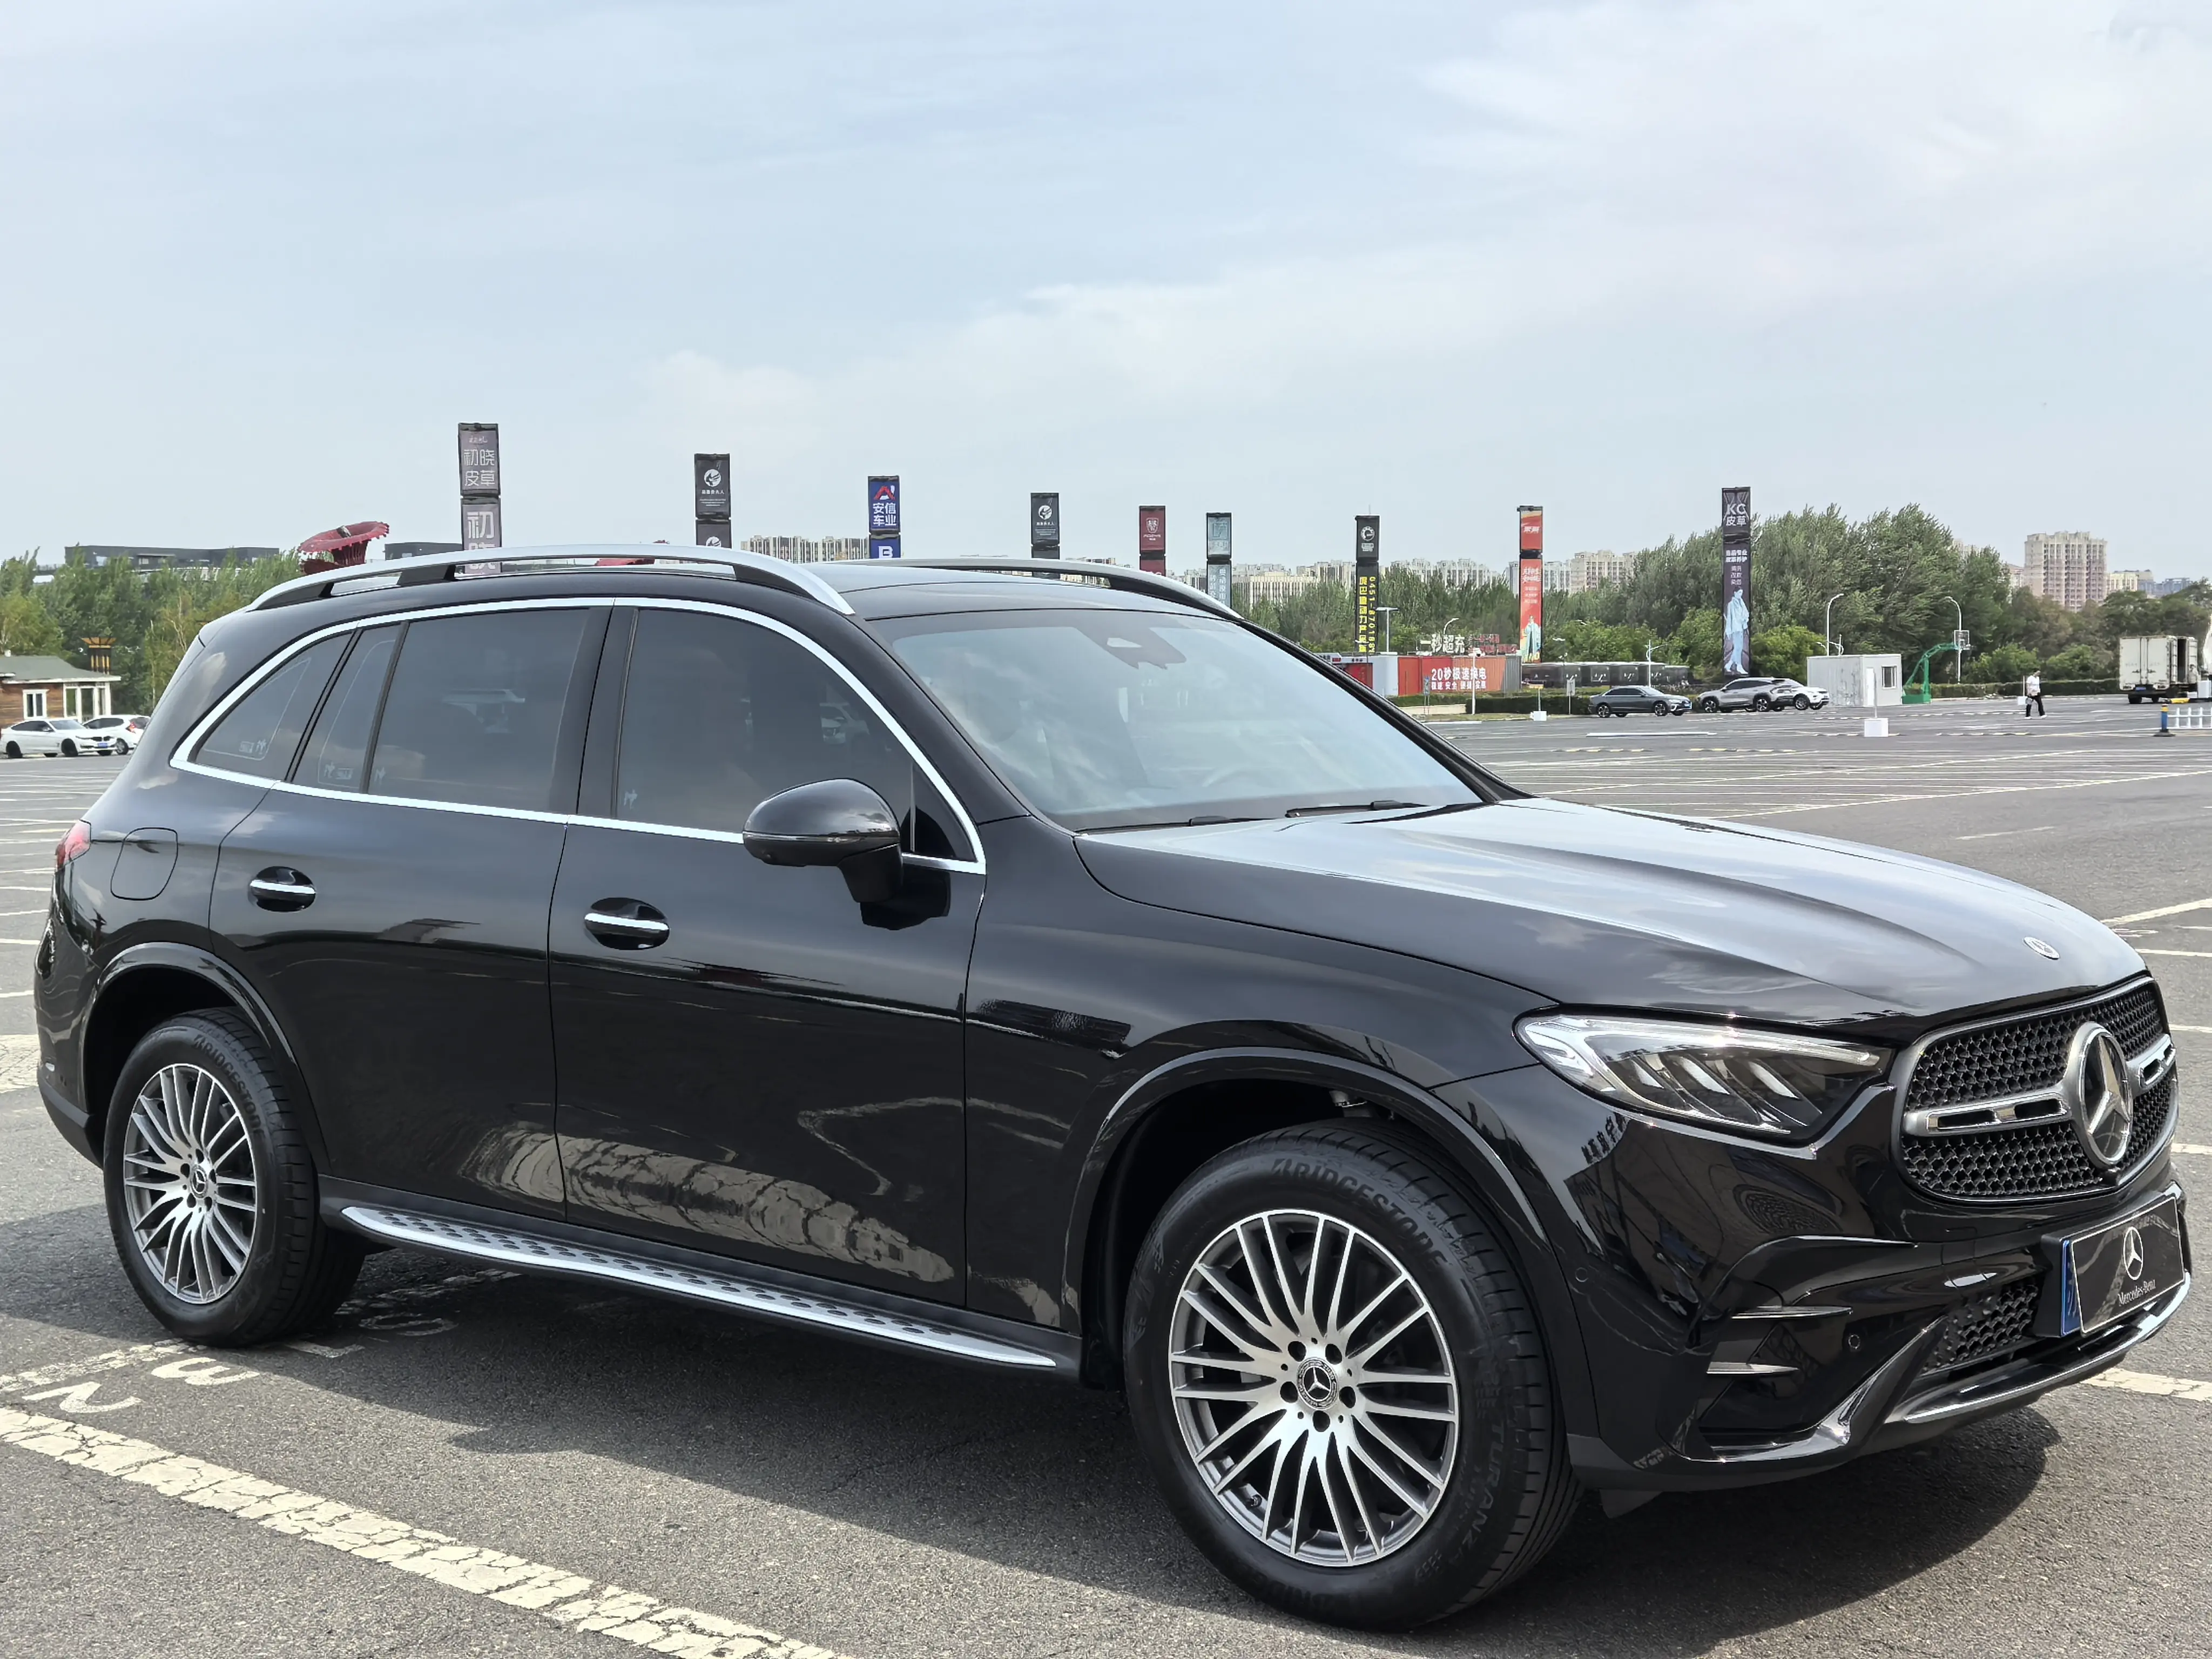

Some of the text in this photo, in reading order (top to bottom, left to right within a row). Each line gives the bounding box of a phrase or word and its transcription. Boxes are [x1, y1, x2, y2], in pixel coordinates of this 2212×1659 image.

[464, 449, 495, 466] 初晓
[464, 470, 495, 486] 皮草
[873, 502, 896, 514] 安信
[873, 514, 896, 526] 车业
[1726, 516, 1746, 526] 皮草
[1270, 1157, 1453, 1268] BRIDGESTONE
